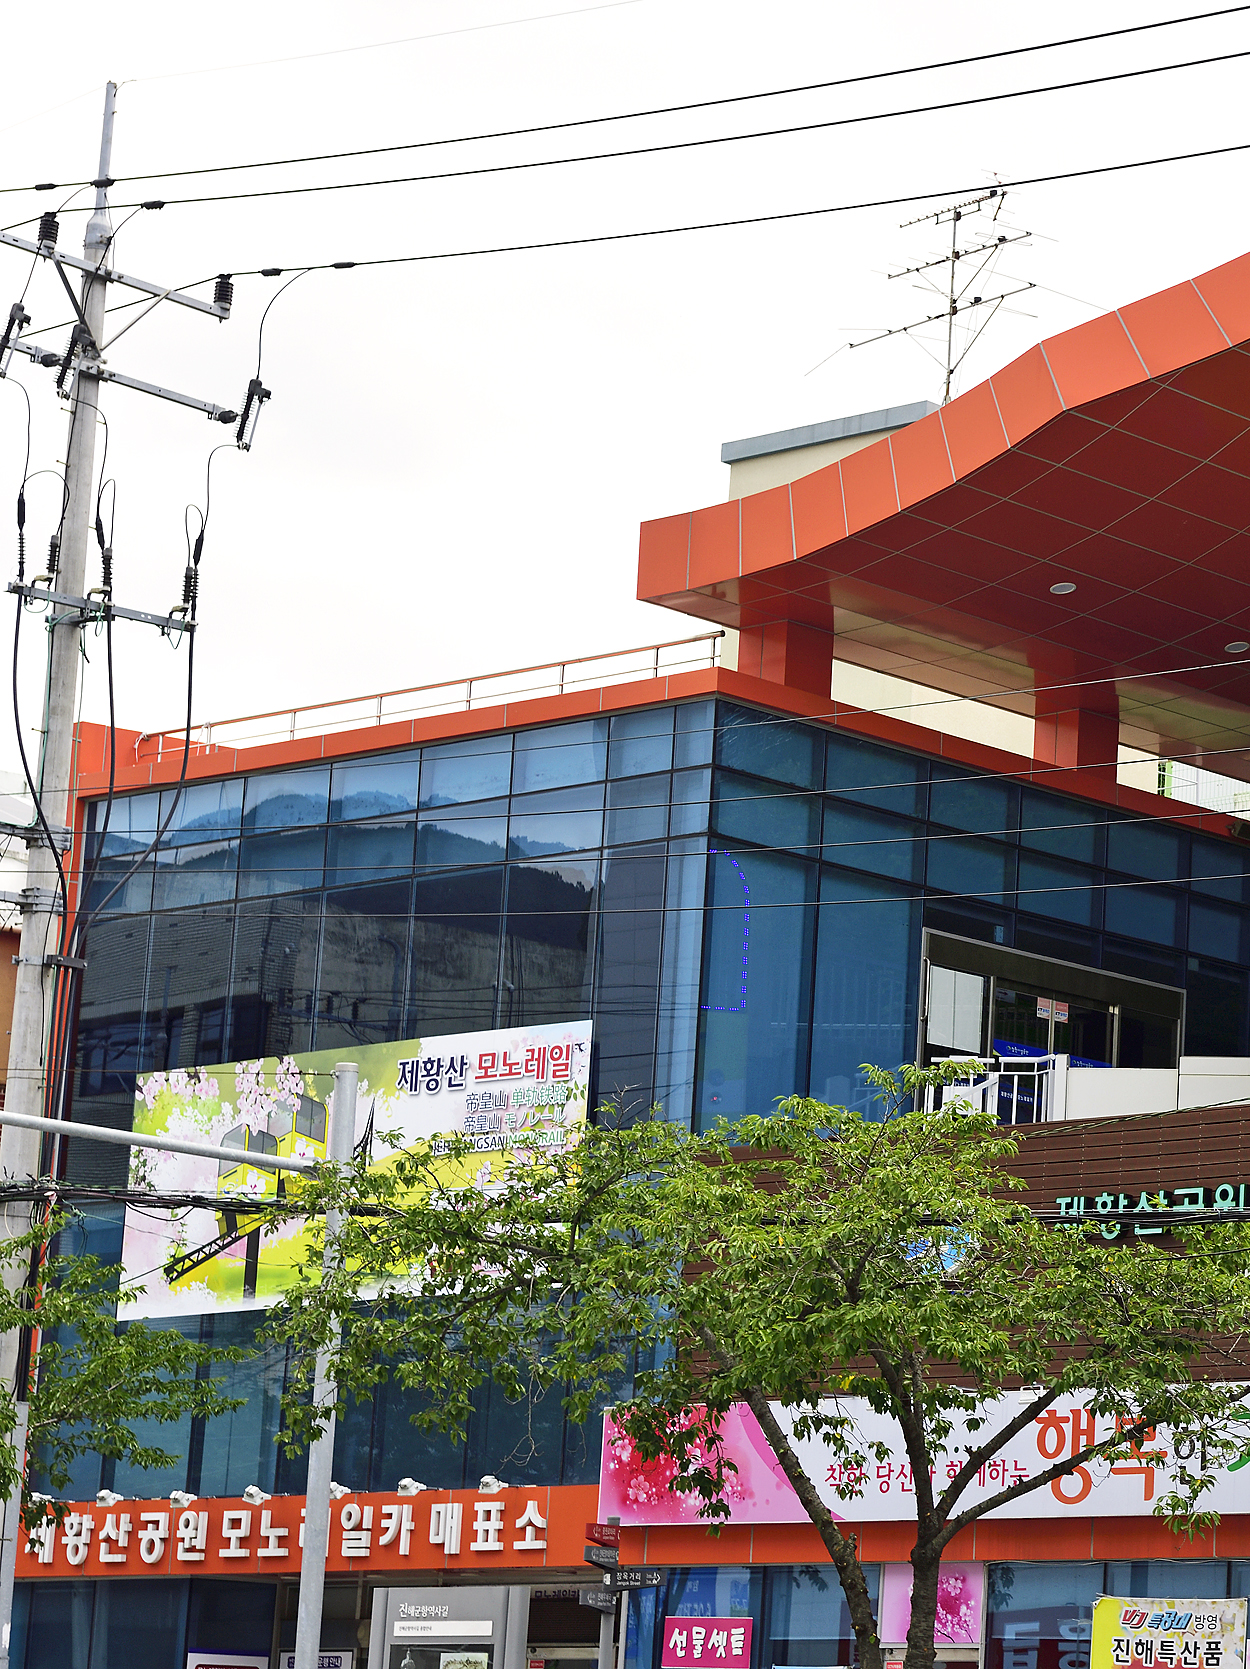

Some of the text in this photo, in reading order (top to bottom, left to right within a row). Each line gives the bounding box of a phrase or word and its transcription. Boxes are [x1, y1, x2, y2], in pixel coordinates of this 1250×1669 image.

[398, 1044, 572, 1092] 제황산 모노레일
[466, 1086, 567, 1113] 帝皇山 单轨铁路
[464, 1109, 566, 1133] 帝皇山 モノレール
[432, 1135, 505, 1156] JEHNGSAN
[876, 1462, 936, 1493] 당신
[219, 1503, 415, 1558] 모노일카
[429, 1500, 548, 1556] 매표소
[1195, 1614, 1218, 1630] 방영
[669, 1626, 745, 1659] 선물셋트
[1112, 1638, 1223, 1666] 진해특산품
